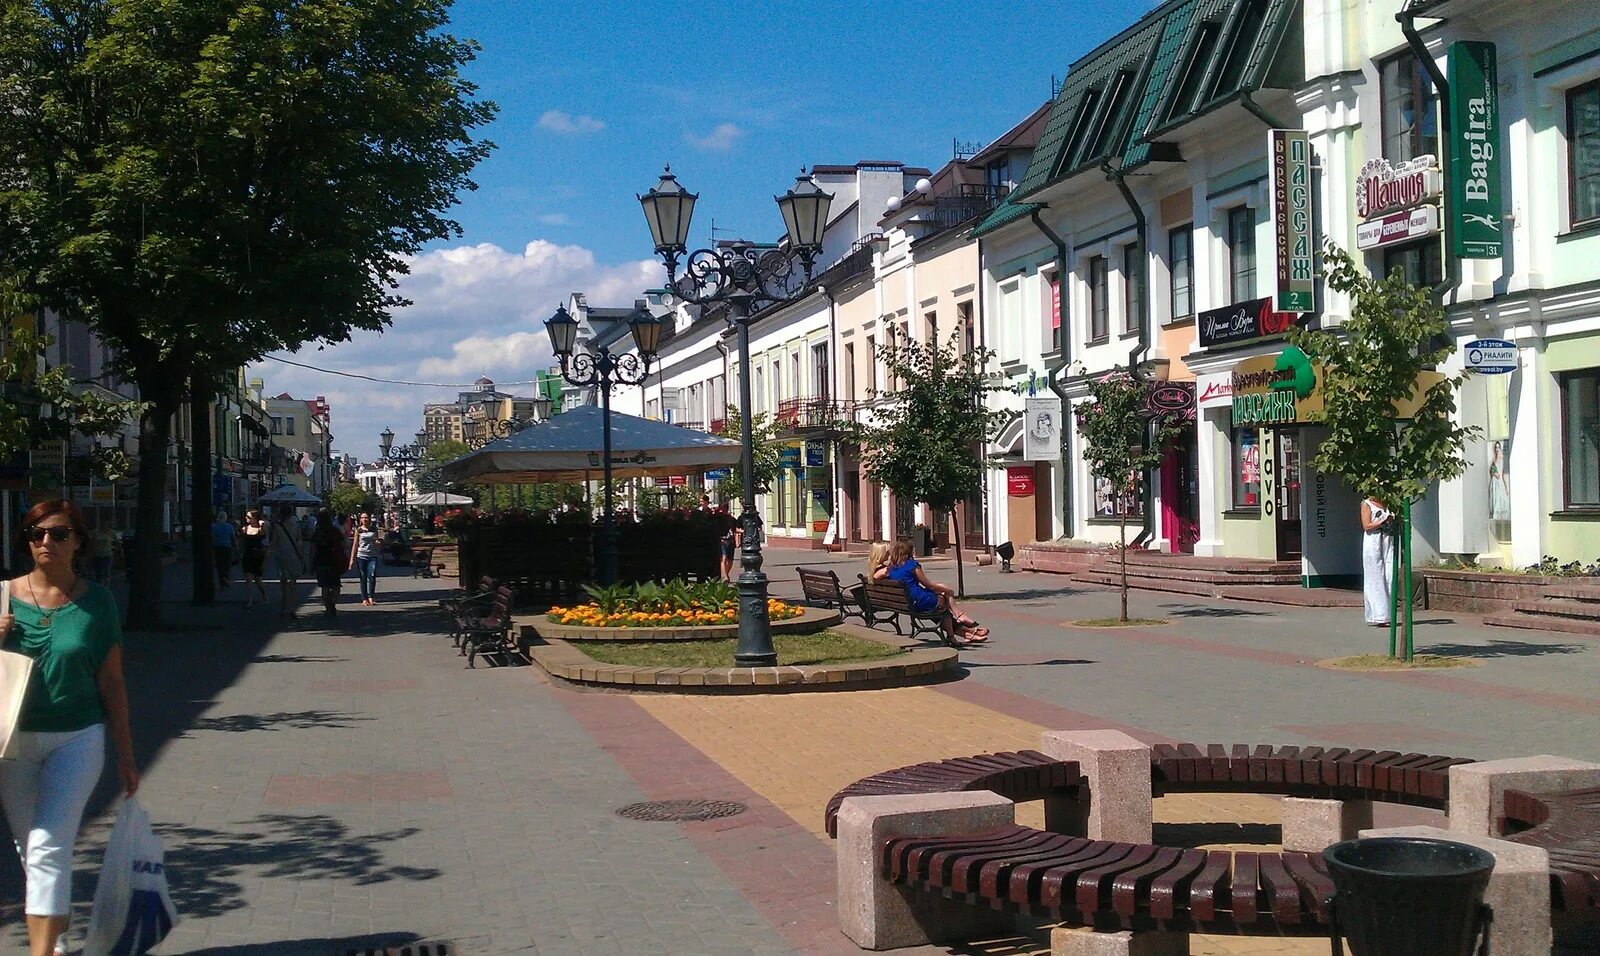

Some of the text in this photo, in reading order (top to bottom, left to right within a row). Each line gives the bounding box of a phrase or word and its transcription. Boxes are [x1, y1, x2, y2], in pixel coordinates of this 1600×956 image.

[1464, 97, 1493, 203] Bagira
[1290, 139, 1311, 281] ПАССАЖ
[1488, 245, 1498, 256] 31
[1290, 292, 1299, 305] 2
[1316, 508, 1326, 538] ЦЕНТР
